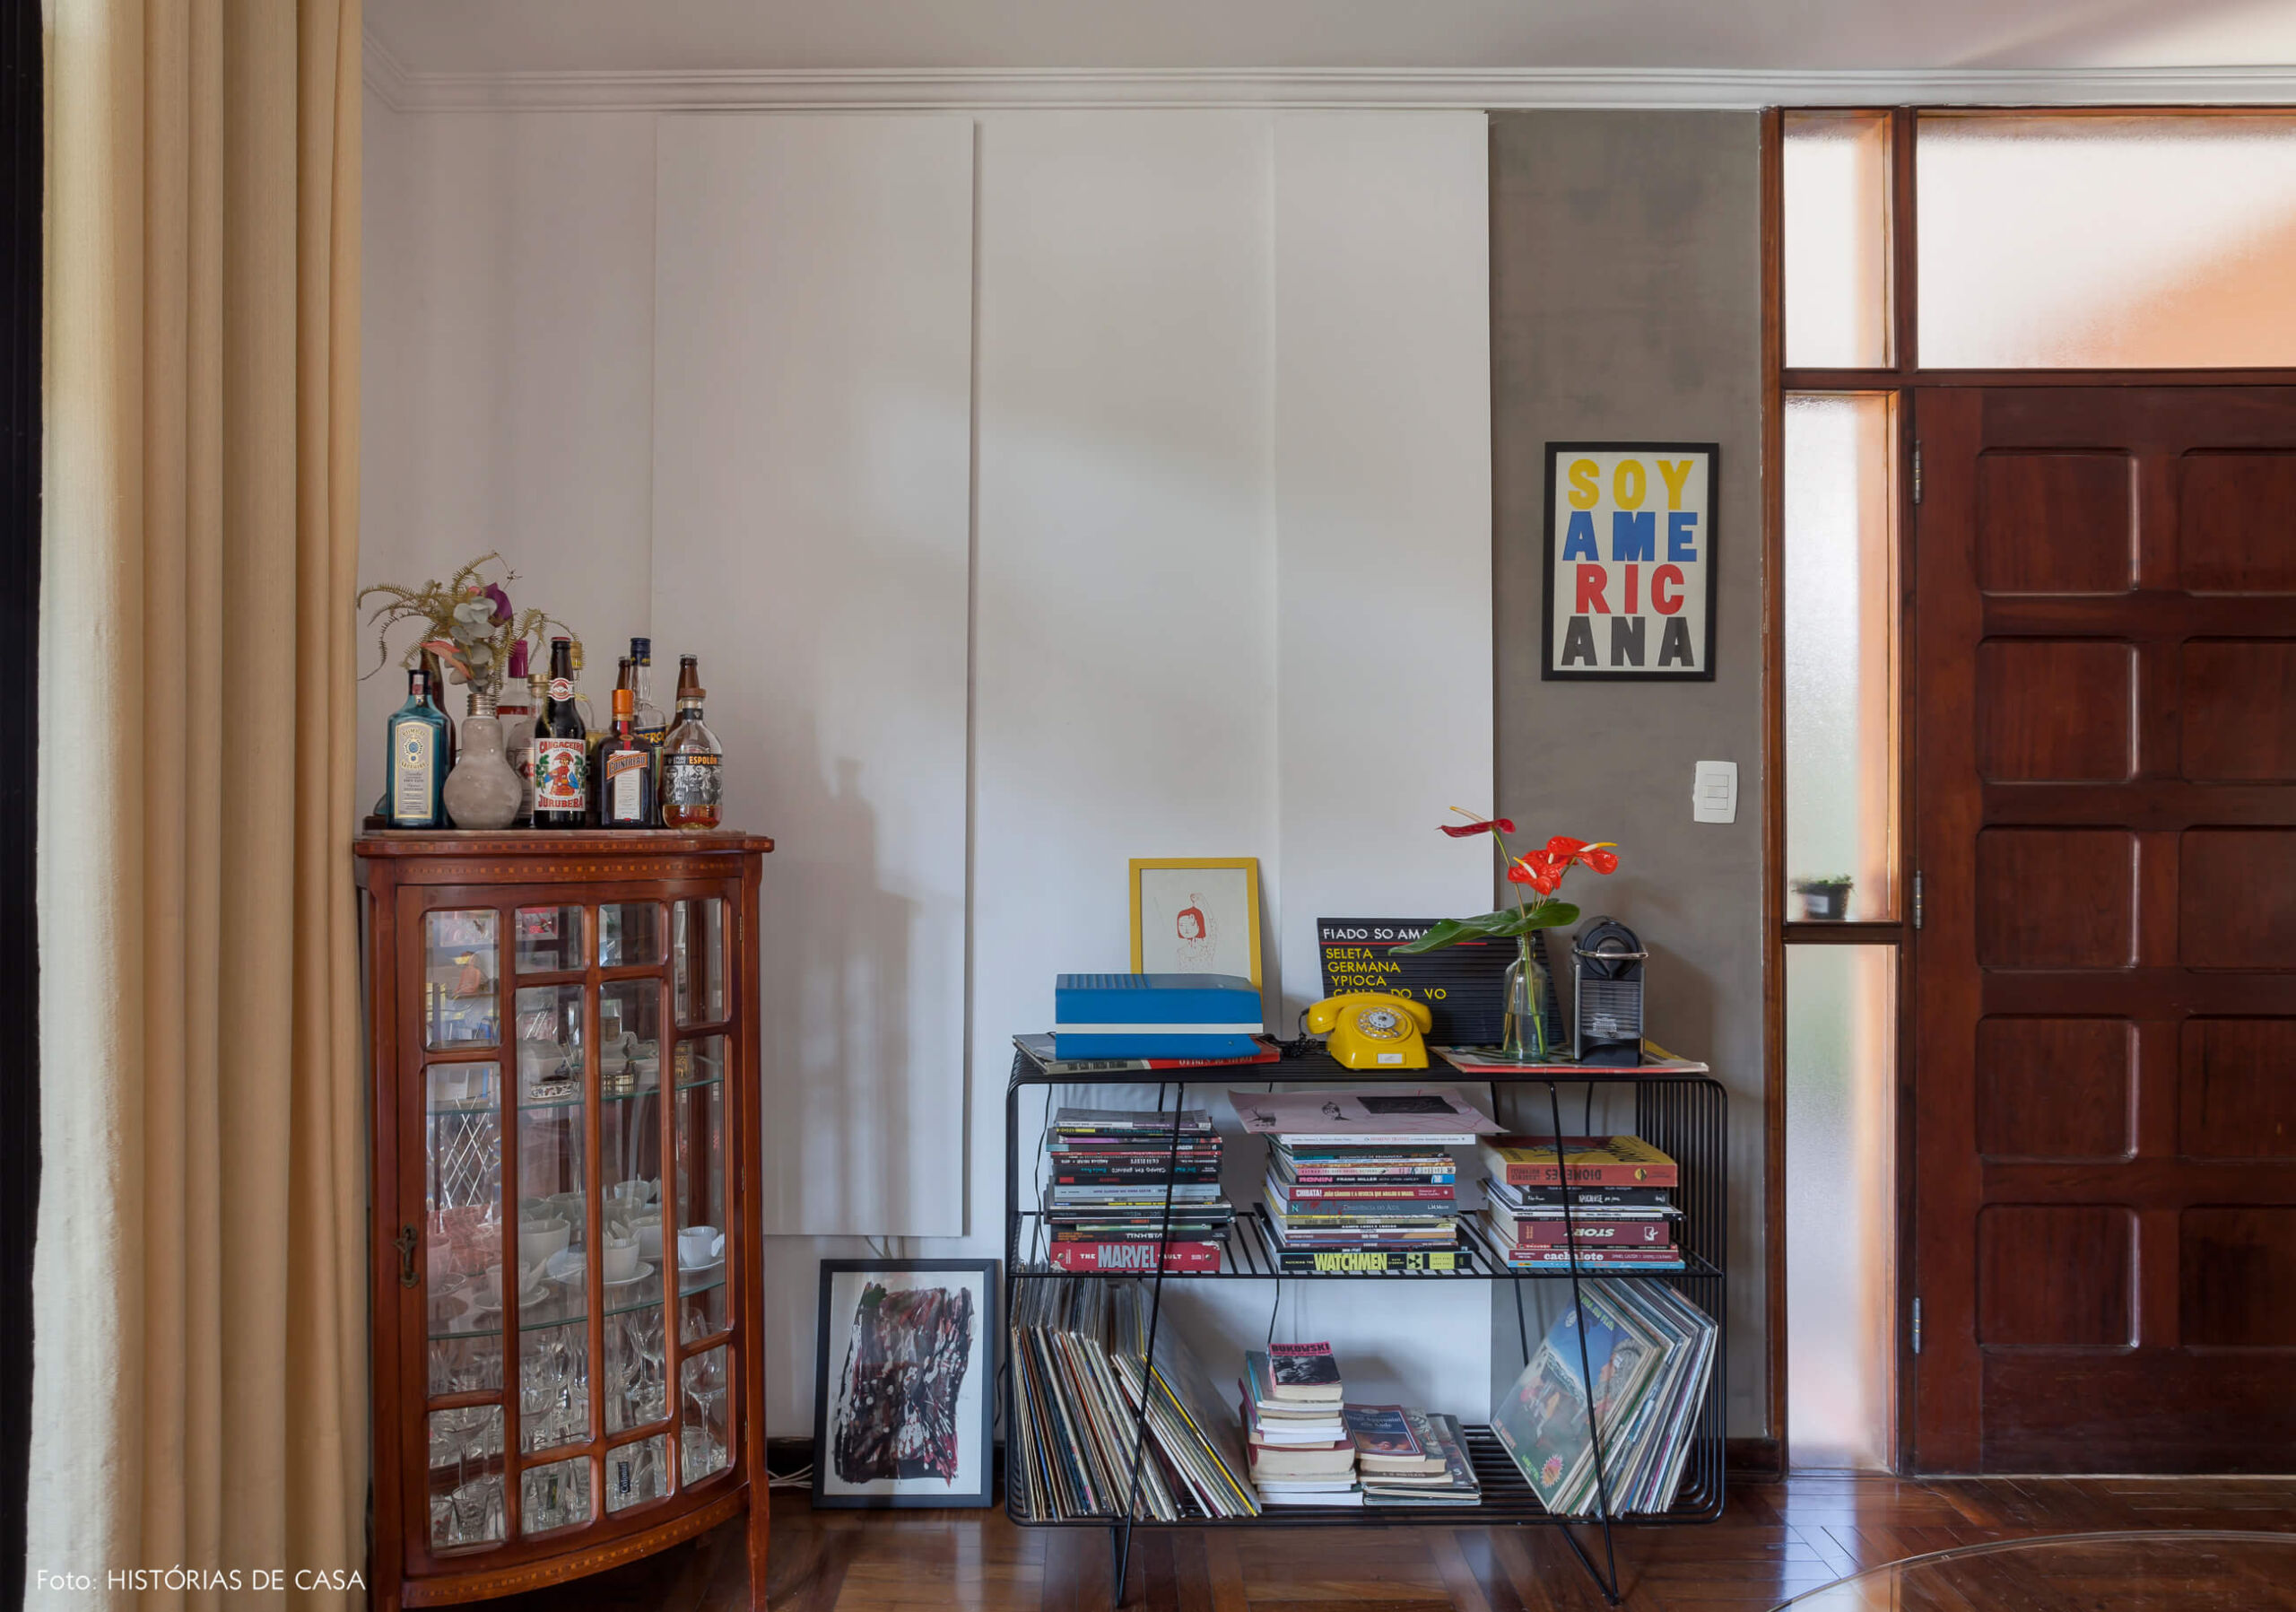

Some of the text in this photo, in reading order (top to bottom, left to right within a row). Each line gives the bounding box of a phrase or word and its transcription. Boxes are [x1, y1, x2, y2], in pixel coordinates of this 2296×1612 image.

[1568, 458, 1693, 510] SOY
[1562, 510, 1698, 562] AME
[1576, 563, 1684, 614] RIC
[1561, 615, 1694, 667] ANA
[609, 754, 646, 772] COINTREAU
[538, 795, 583, 807] JURUBEBA
[1323, 928, 1368, 940] FIADO
[1374, 928, 1394, 940] SO
[1326, 947, 1373, 959] SELETA
[1327, 961, 1401, 972] GERMANA
[1331, 975, 1387, 987] YPIOCA
[1423, 989, 1447, 1000] VO
[1544, 1169, 1602, 1180] DIOMEES
[1563, 1228, 1614, 1237] STOR
[1098, 1245, 1158, 1268] MARVEL
[1314, 1253, 1387, 1270] WATCHMEN
[1271, 1342, 1330, 1352] BUKOWSKI
